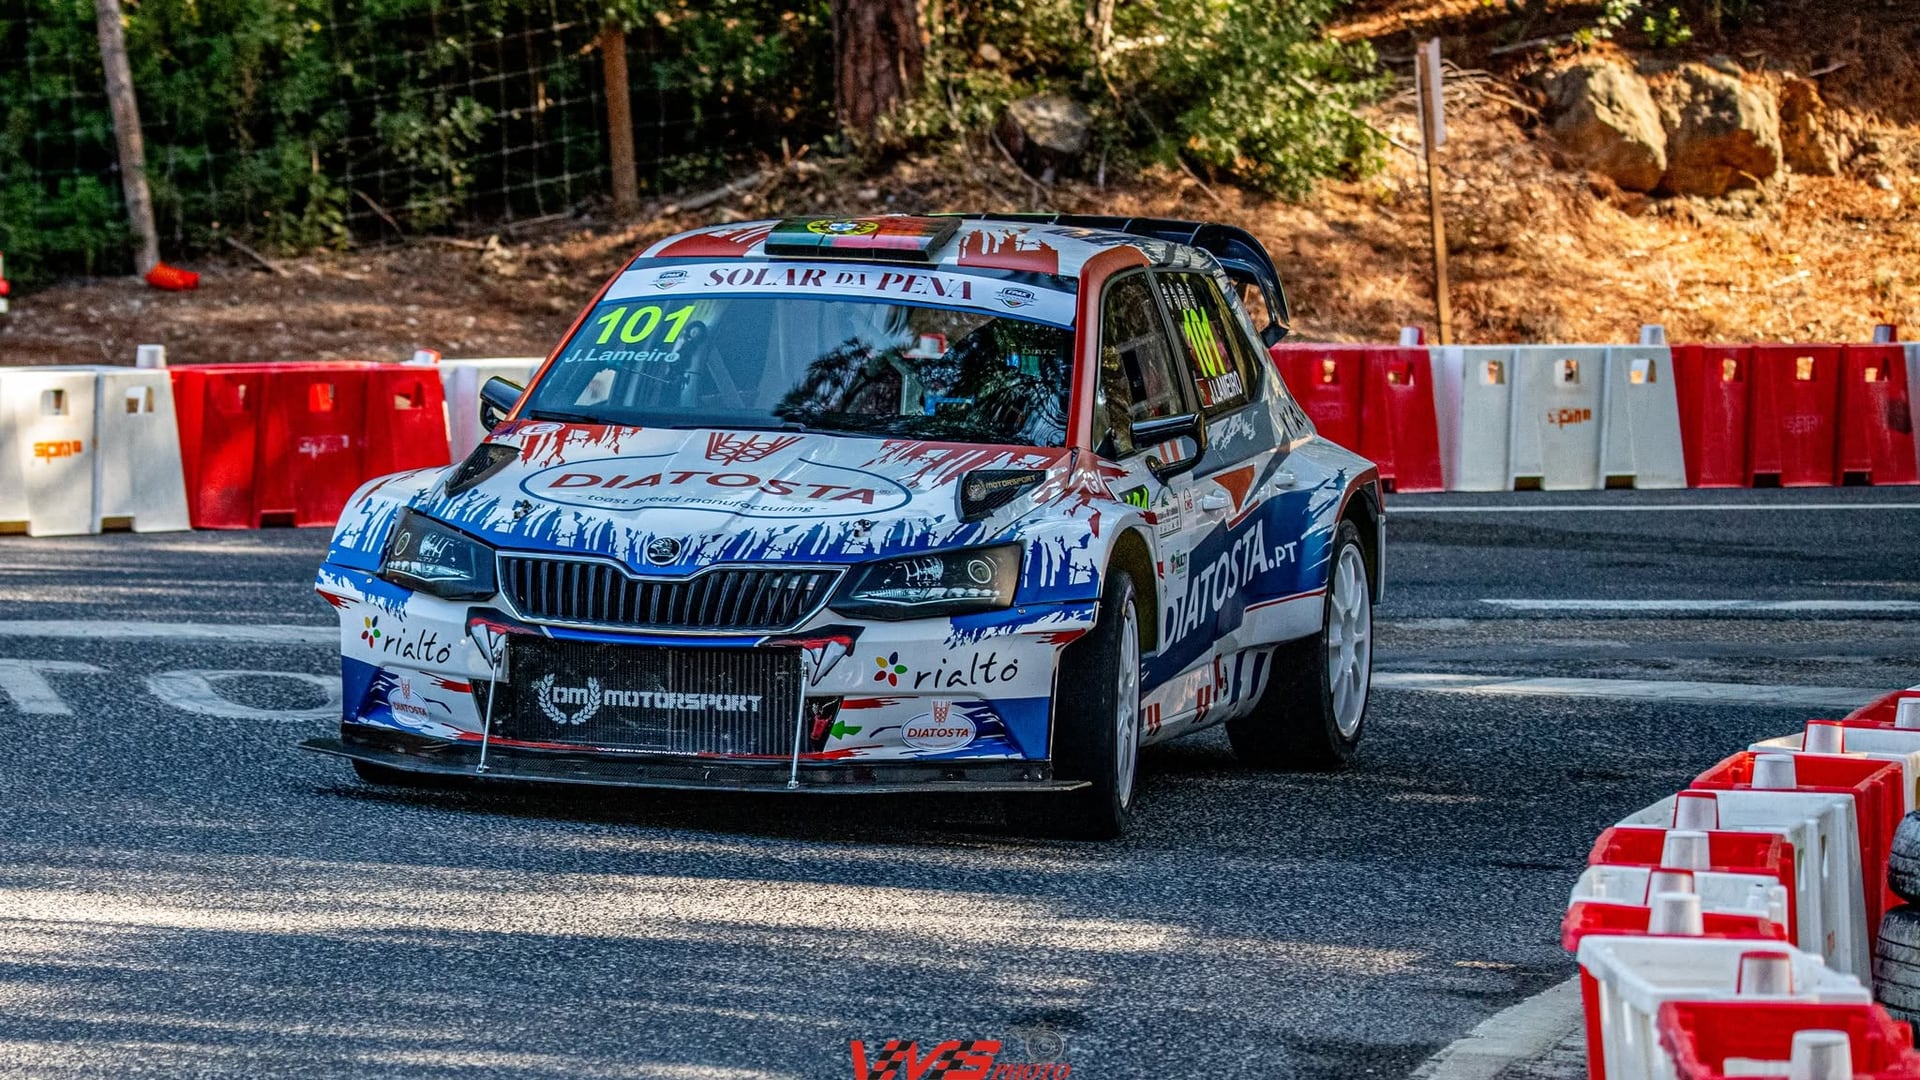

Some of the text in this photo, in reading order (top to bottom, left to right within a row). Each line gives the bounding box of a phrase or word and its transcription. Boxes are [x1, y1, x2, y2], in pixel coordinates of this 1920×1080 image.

[704, 268, 972, 300] SOLAR DA PENA
[596, 305, 696, 345] 101
[1182, 305, 1226, 378] 101
[565, 348, 680, 363] J.Lameiro
[548, 471, 875, 505] DIATOSTA
[588, 495, 629, 504] toast
[684, 496, 815, 513] manufacturing
[384, 628, 451, 663] rialto
[914, 652, 1018, 689] rialto
[553, 686, 763, 712] DM MOTORSPORT
[907, 727, 969, 738] DIATOSTA
